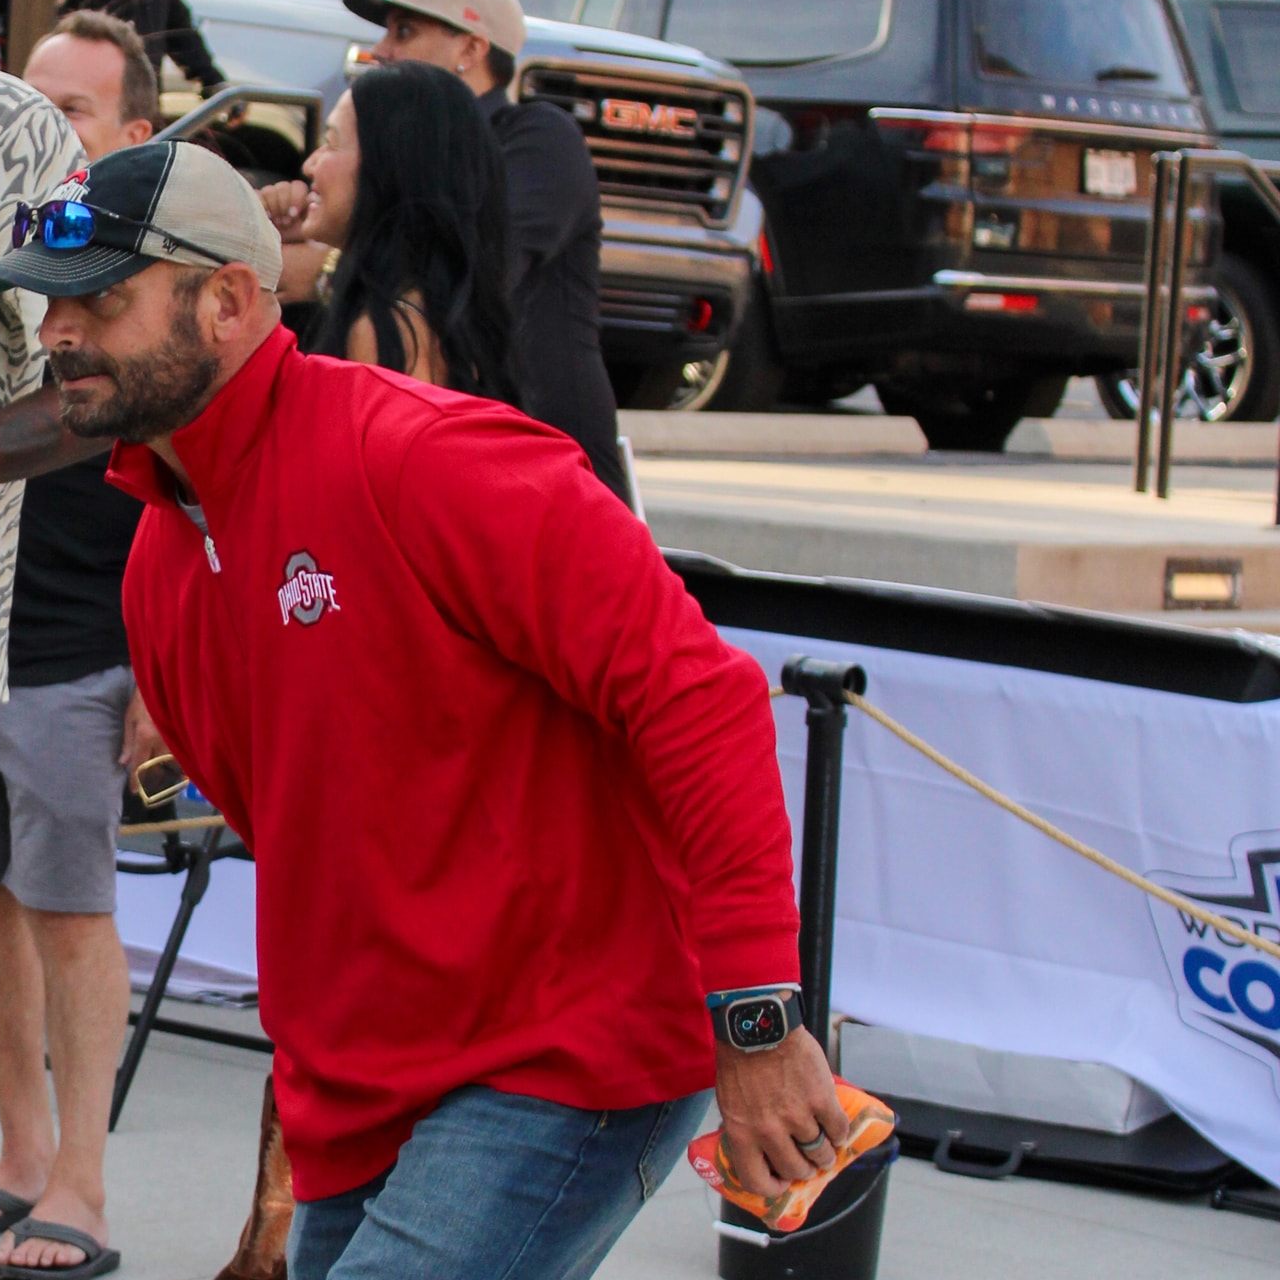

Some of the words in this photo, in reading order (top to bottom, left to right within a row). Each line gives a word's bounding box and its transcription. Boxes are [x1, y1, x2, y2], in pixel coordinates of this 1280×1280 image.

[601, 98, 698, 136] GMC
[277, 576, 302, 626] OHIO
[298, 569, 342, 612] STATE
